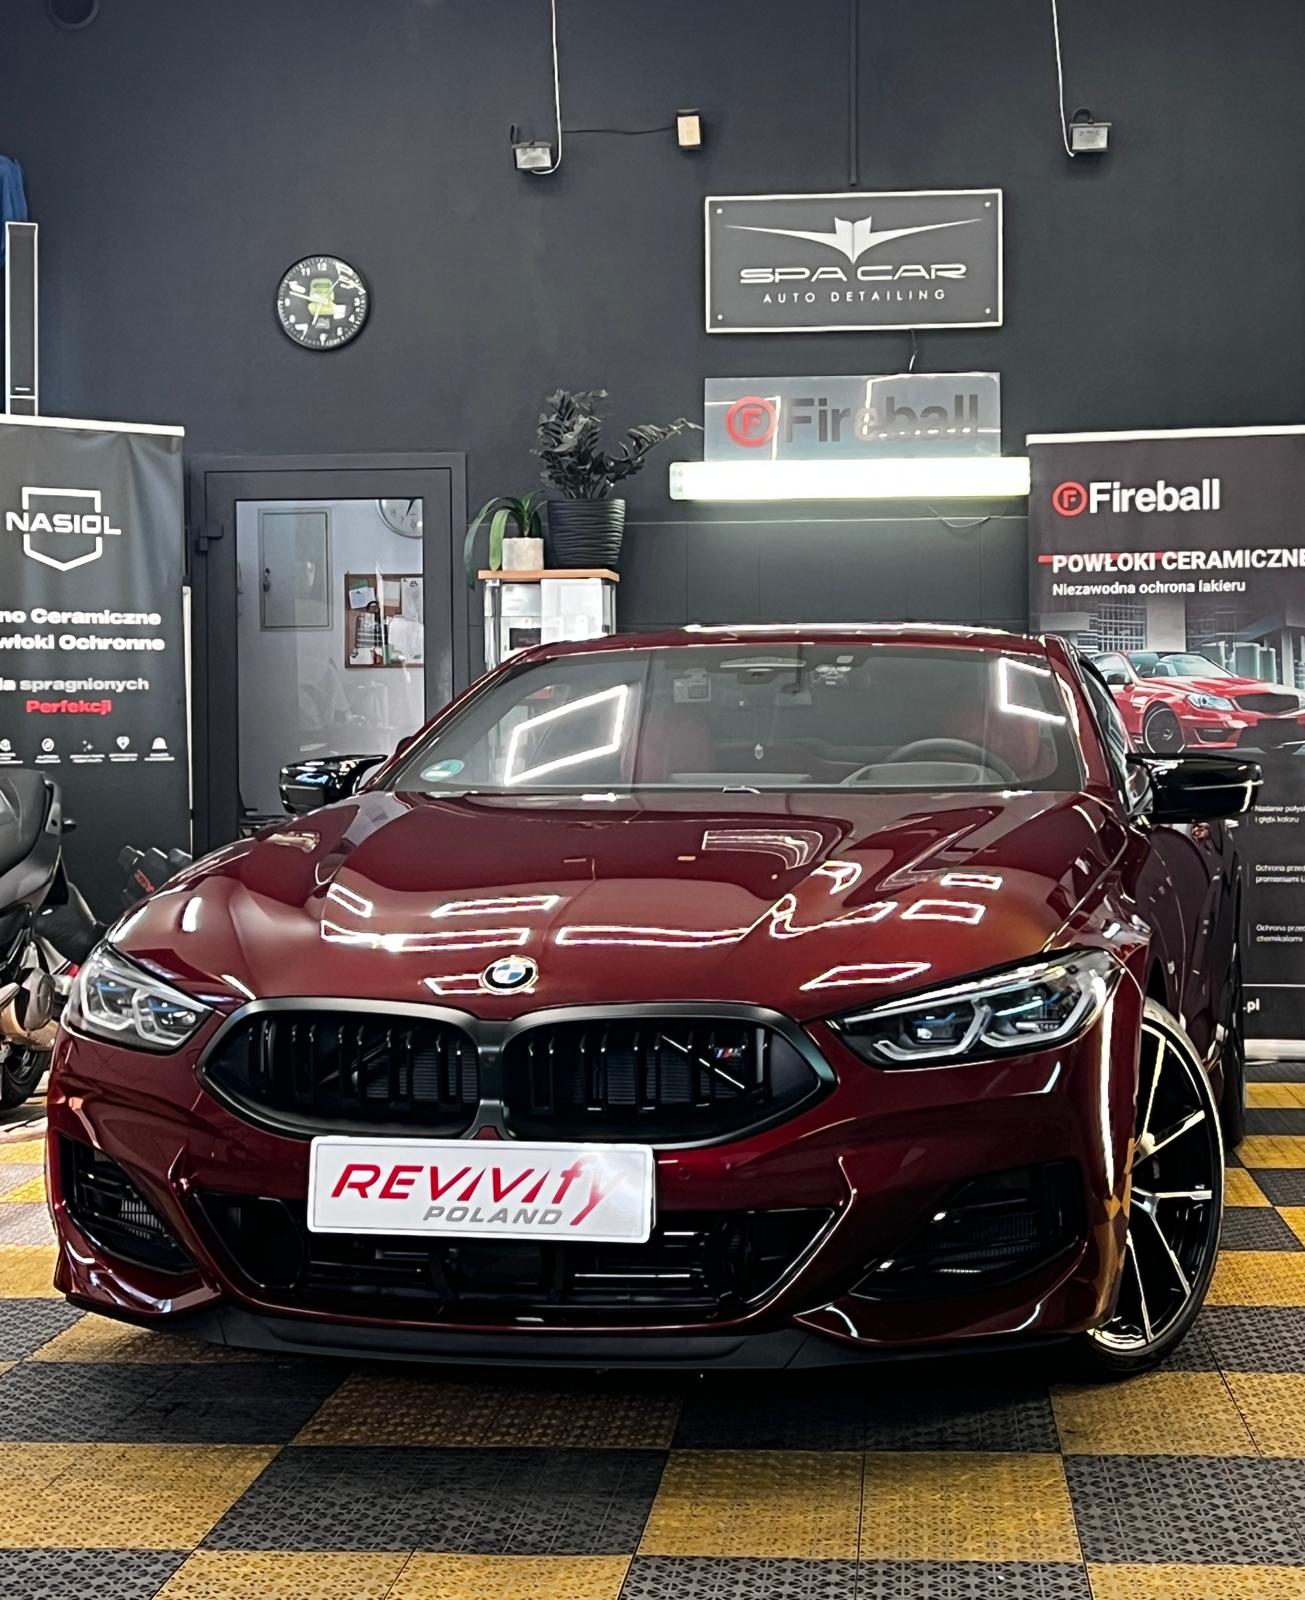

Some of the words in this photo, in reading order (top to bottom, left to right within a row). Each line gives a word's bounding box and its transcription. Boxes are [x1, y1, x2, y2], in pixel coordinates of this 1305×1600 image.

[317, 262, 327, 271] 12
[740, 267, 848, 284] SPA
[856, 263, 967, 281] CAR
[763, 291, 816, 304] AUTO
[830, 288, 946, 302] DETAILING
[783, 394, 979, 443] Fireball
[1089, 478, 1220, 513] Fireball
[5, 511, 121, 535] NASIOL
[1052, 552, 1156, 574] POWŁOKI
[1053, 581, 1136, 596] Niezawodna
[1138, 580, 1196, 594] ochrona
[1198, 578, 1246, 592] lakieru
[30, 608, 161, 625] Ceramiczne
[58, 634, 166, 651] Ochronne
[19, 677, 150, 693] spragnionych
[26, 699, 112, 715] Perfekcji
[1255, 864, 1285, 872] Ochrona
[1256, 924, 1286, 932] Ochrona
[423, 1205, 563, 1226] POLAND
